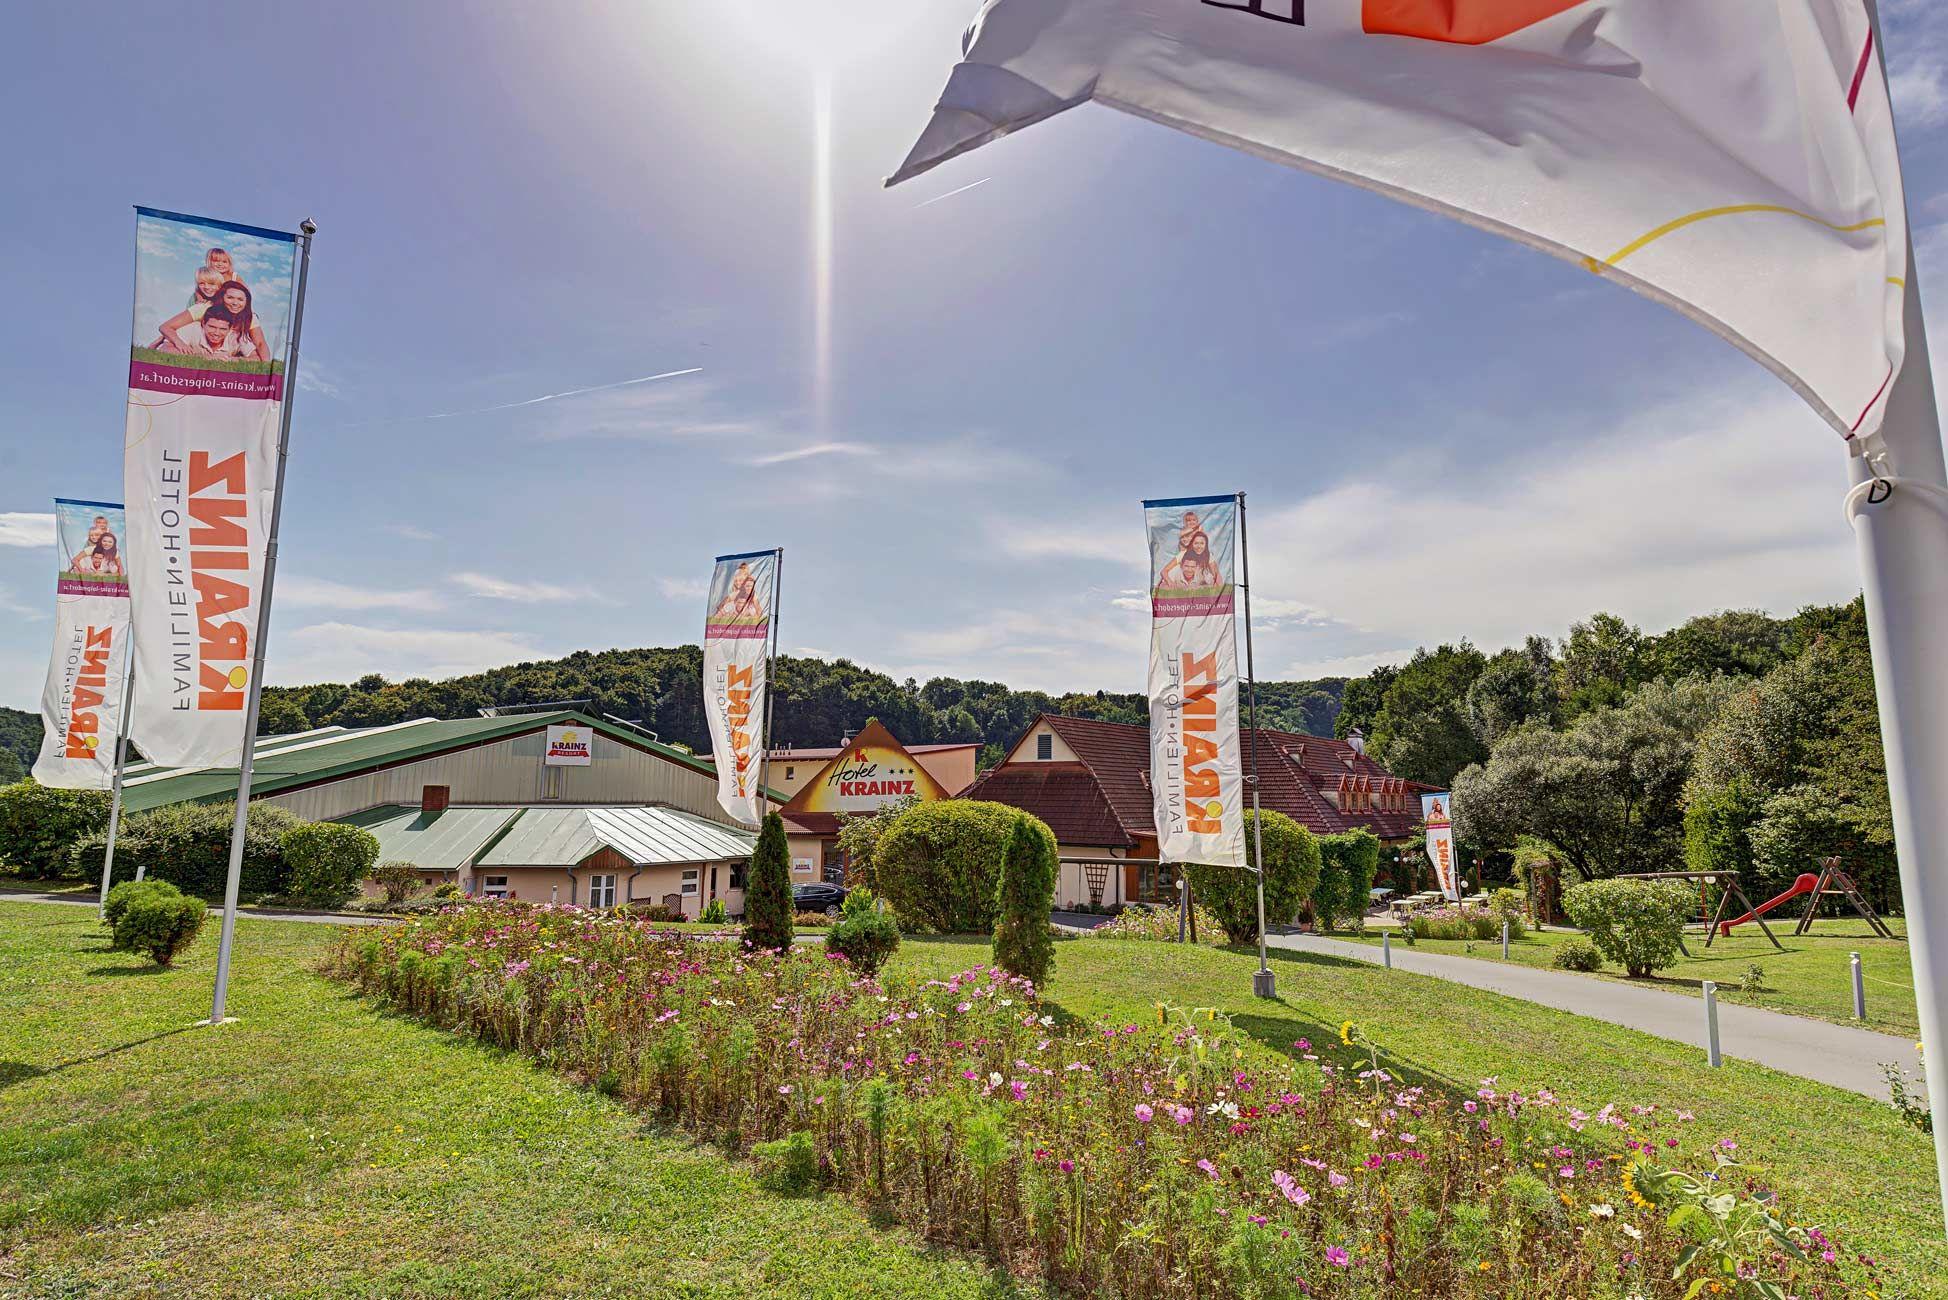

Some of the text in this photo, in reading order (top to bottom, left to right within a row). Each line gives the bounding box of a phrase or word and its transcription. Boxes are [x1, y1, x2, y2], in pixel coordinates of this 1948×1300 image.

[552, 742, 587, 750] KRAINZ
[828, 757, 878, 786] Hotel
[840, 781, 915, 796] KRAINZ
